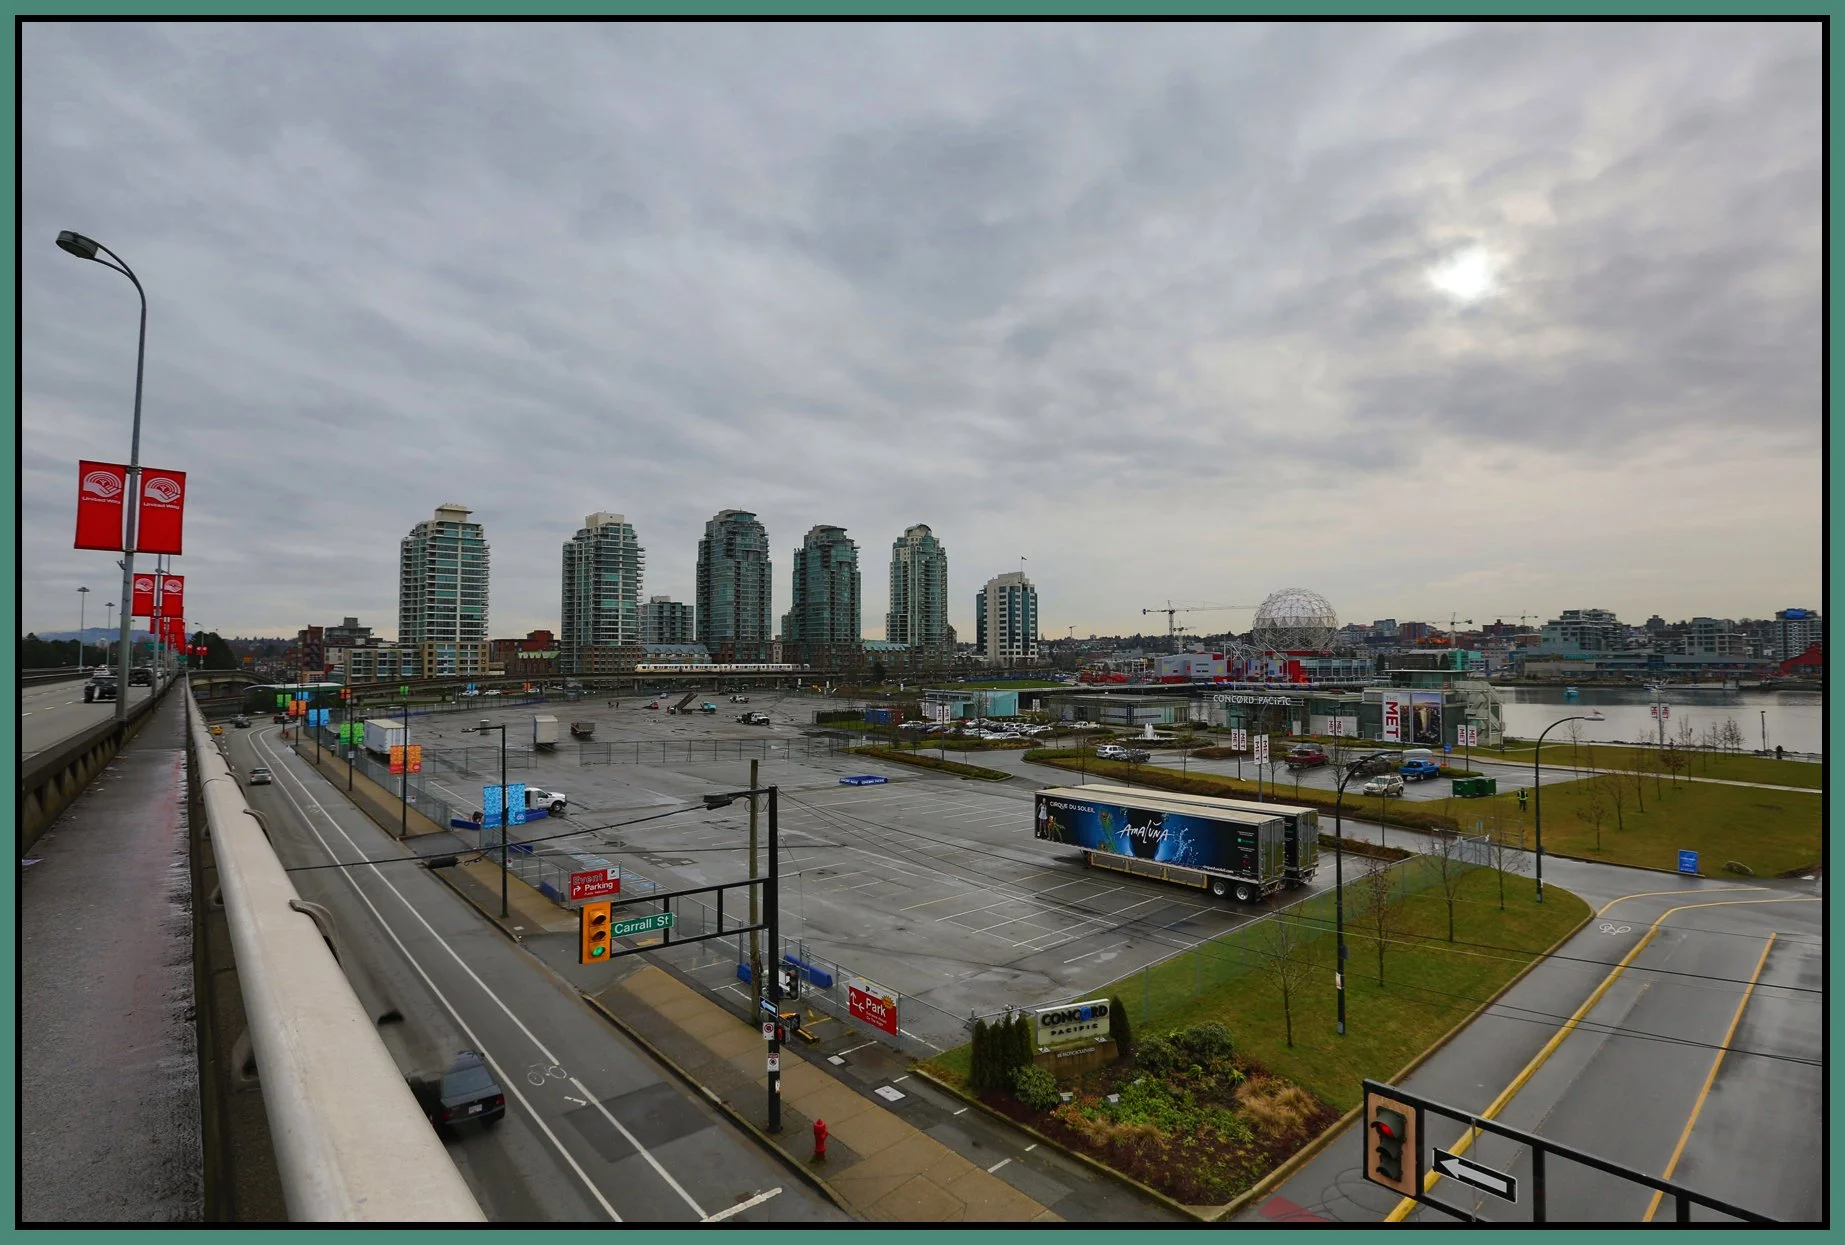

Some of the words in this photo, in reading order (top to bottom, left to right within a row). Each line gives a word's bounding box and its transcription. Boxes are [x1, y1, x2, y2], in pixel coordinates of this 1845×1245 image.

[1258, 696, 1291, 706] PACIFIC
[1385, 701, 1399, 738] MET
[1049, 801, 1068, 809] CIRQUE
[1077, 805, 1096, 814] SOLEIL
[572, 873, 603, 885] Event
[584, 882, 614, 892] Parking
[614, 918, 652, 934] Carrall
[657, 915, 669, 926] St
[866, 997, 886, 1017] Park
[1041, 1005, 1108, 1026] CONCORD
[1051, 1023, 1098, 1036] PACIFIC
